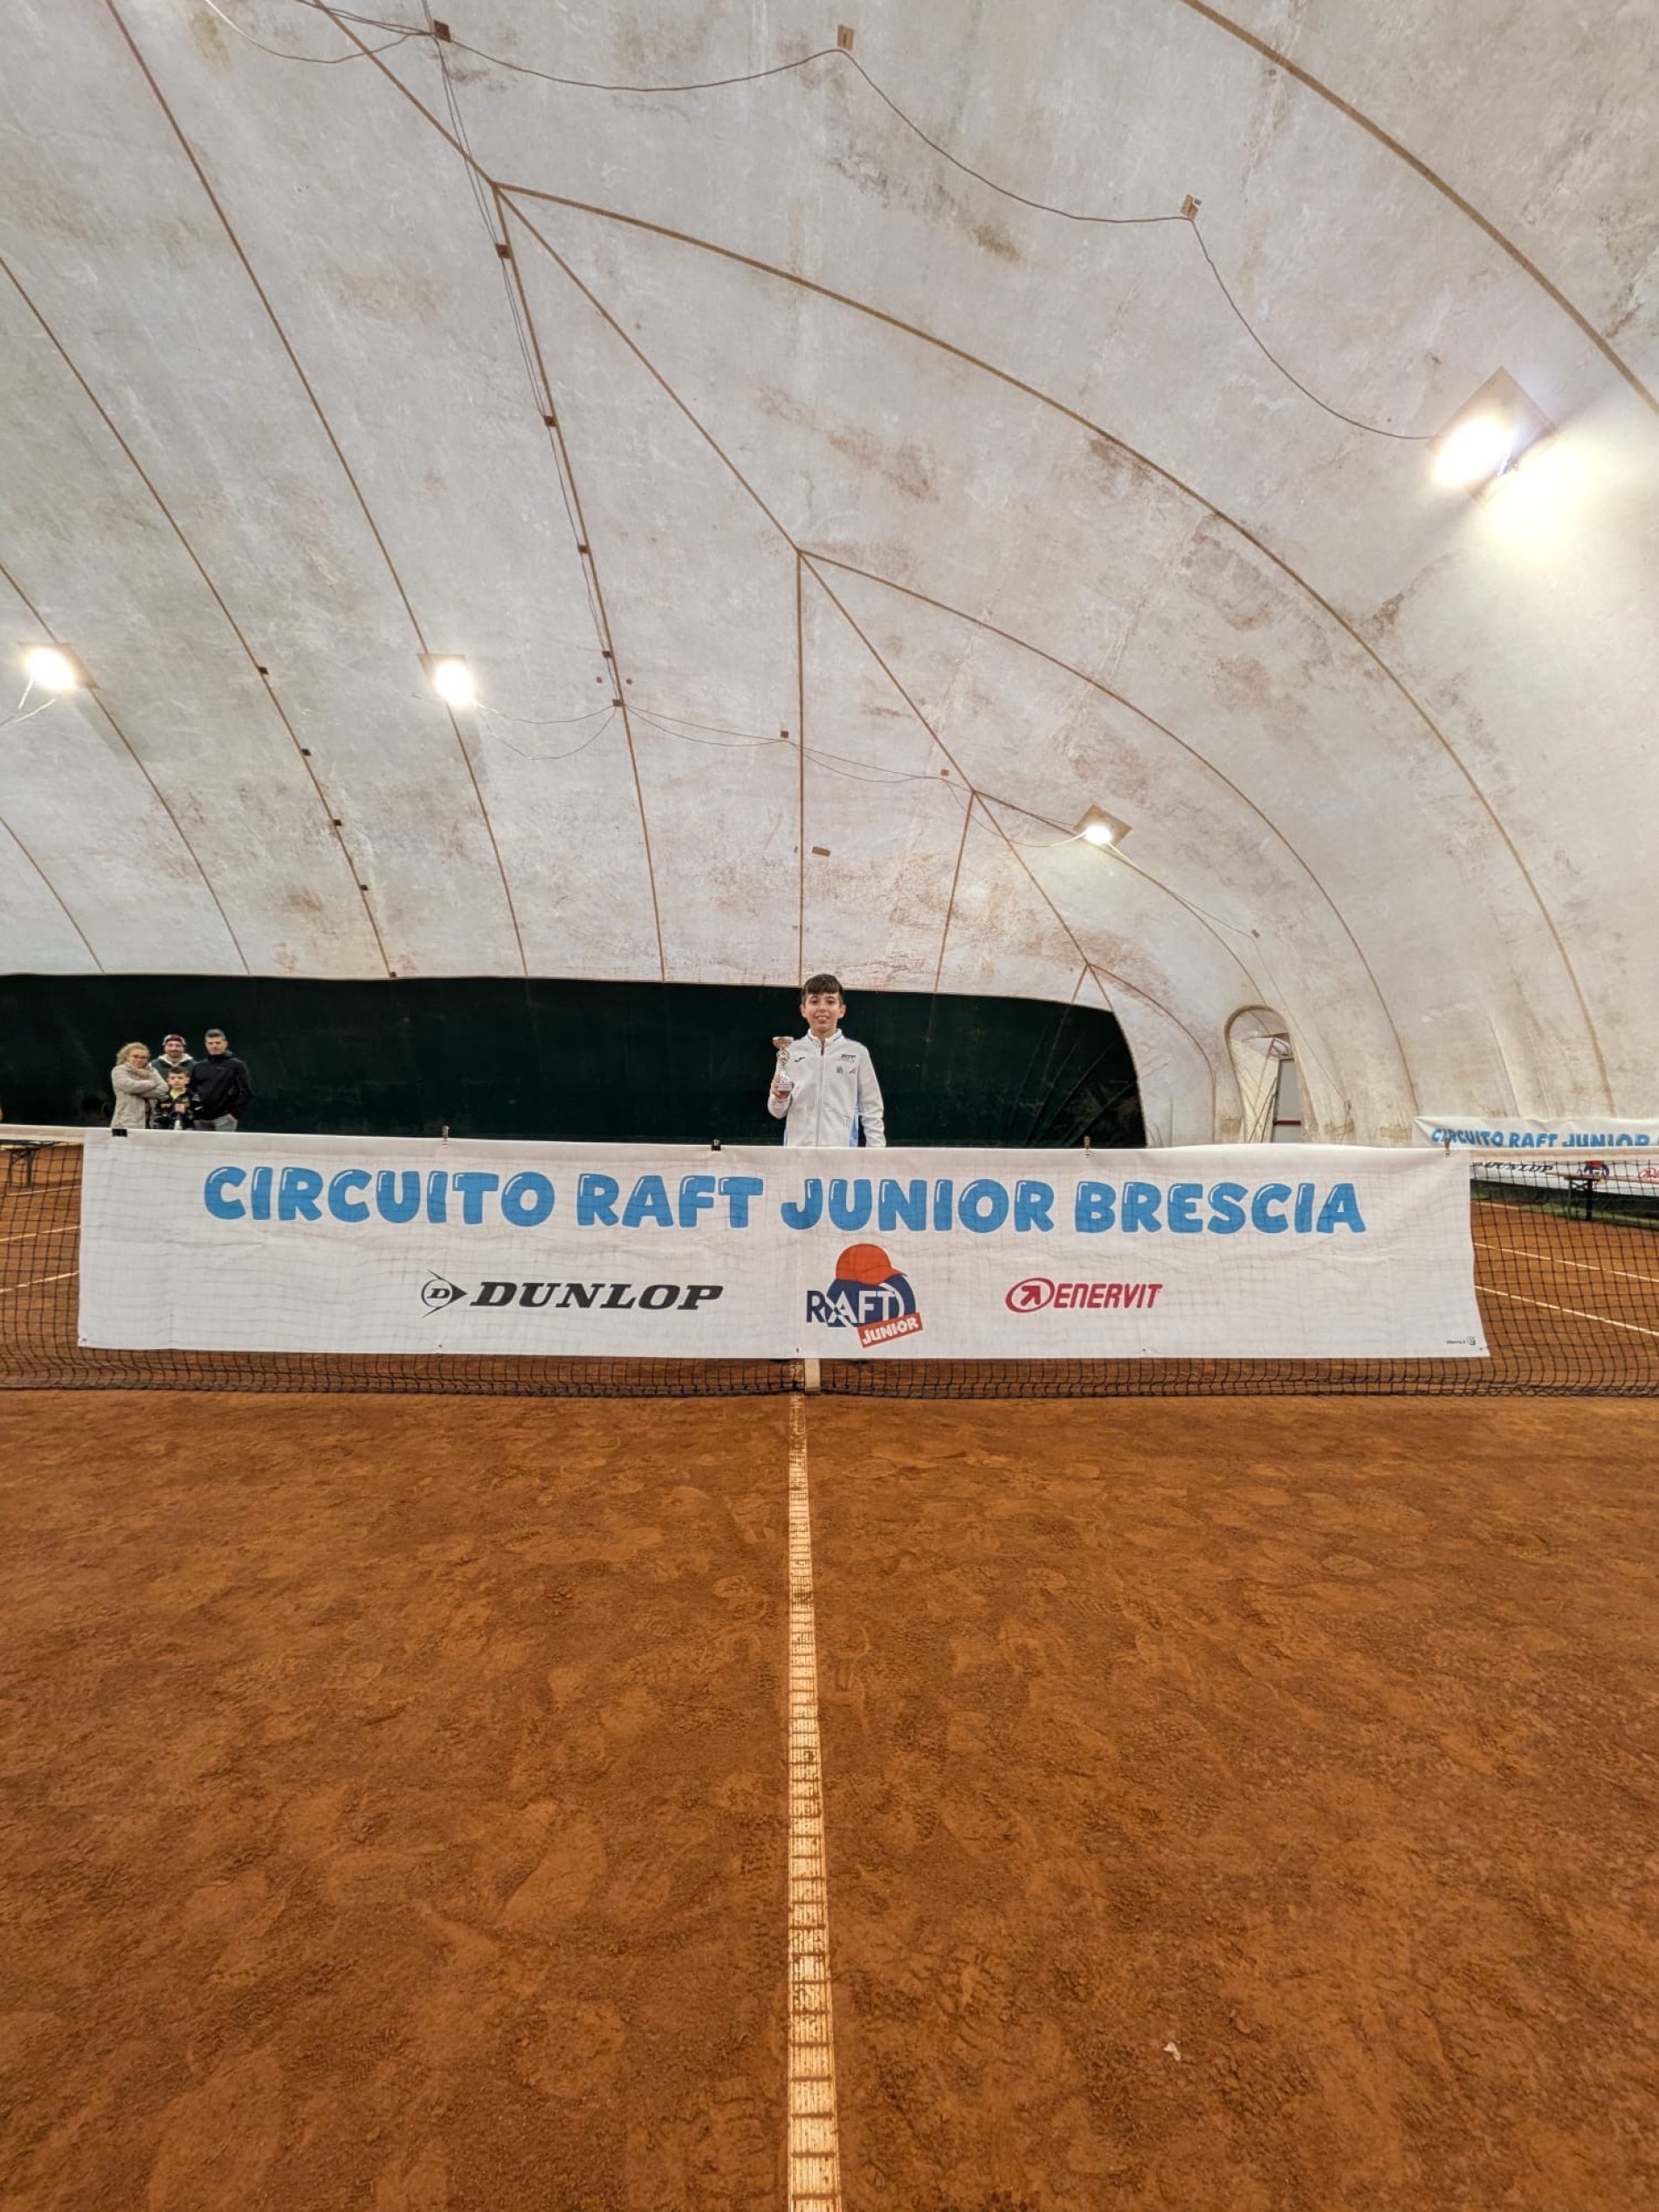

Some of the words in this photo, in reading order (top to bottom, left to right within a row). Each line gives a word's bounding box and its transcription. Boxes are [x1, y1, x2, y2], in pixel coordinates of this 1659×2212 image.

[1431, 1127, 1504, 1147] CIRCUITO
[1509, 1132, 1558, 1148] RAFT
[205, 1167, 554, 1227] CIRCUITO
[576, 1174, 764, 1229] RAFT
[780, 1178, 1054, 1233] JUNIOR
[1075, 1182, 1366, 1234] BRESCIA
[469, 1281, 724, 1310] DUNLOP
[806, 1290, 897, 1325] RAFT
[1053, 1283, 1163, 1308] ENERVIT
[862, 1316, 919, 1345] JUNIOR
